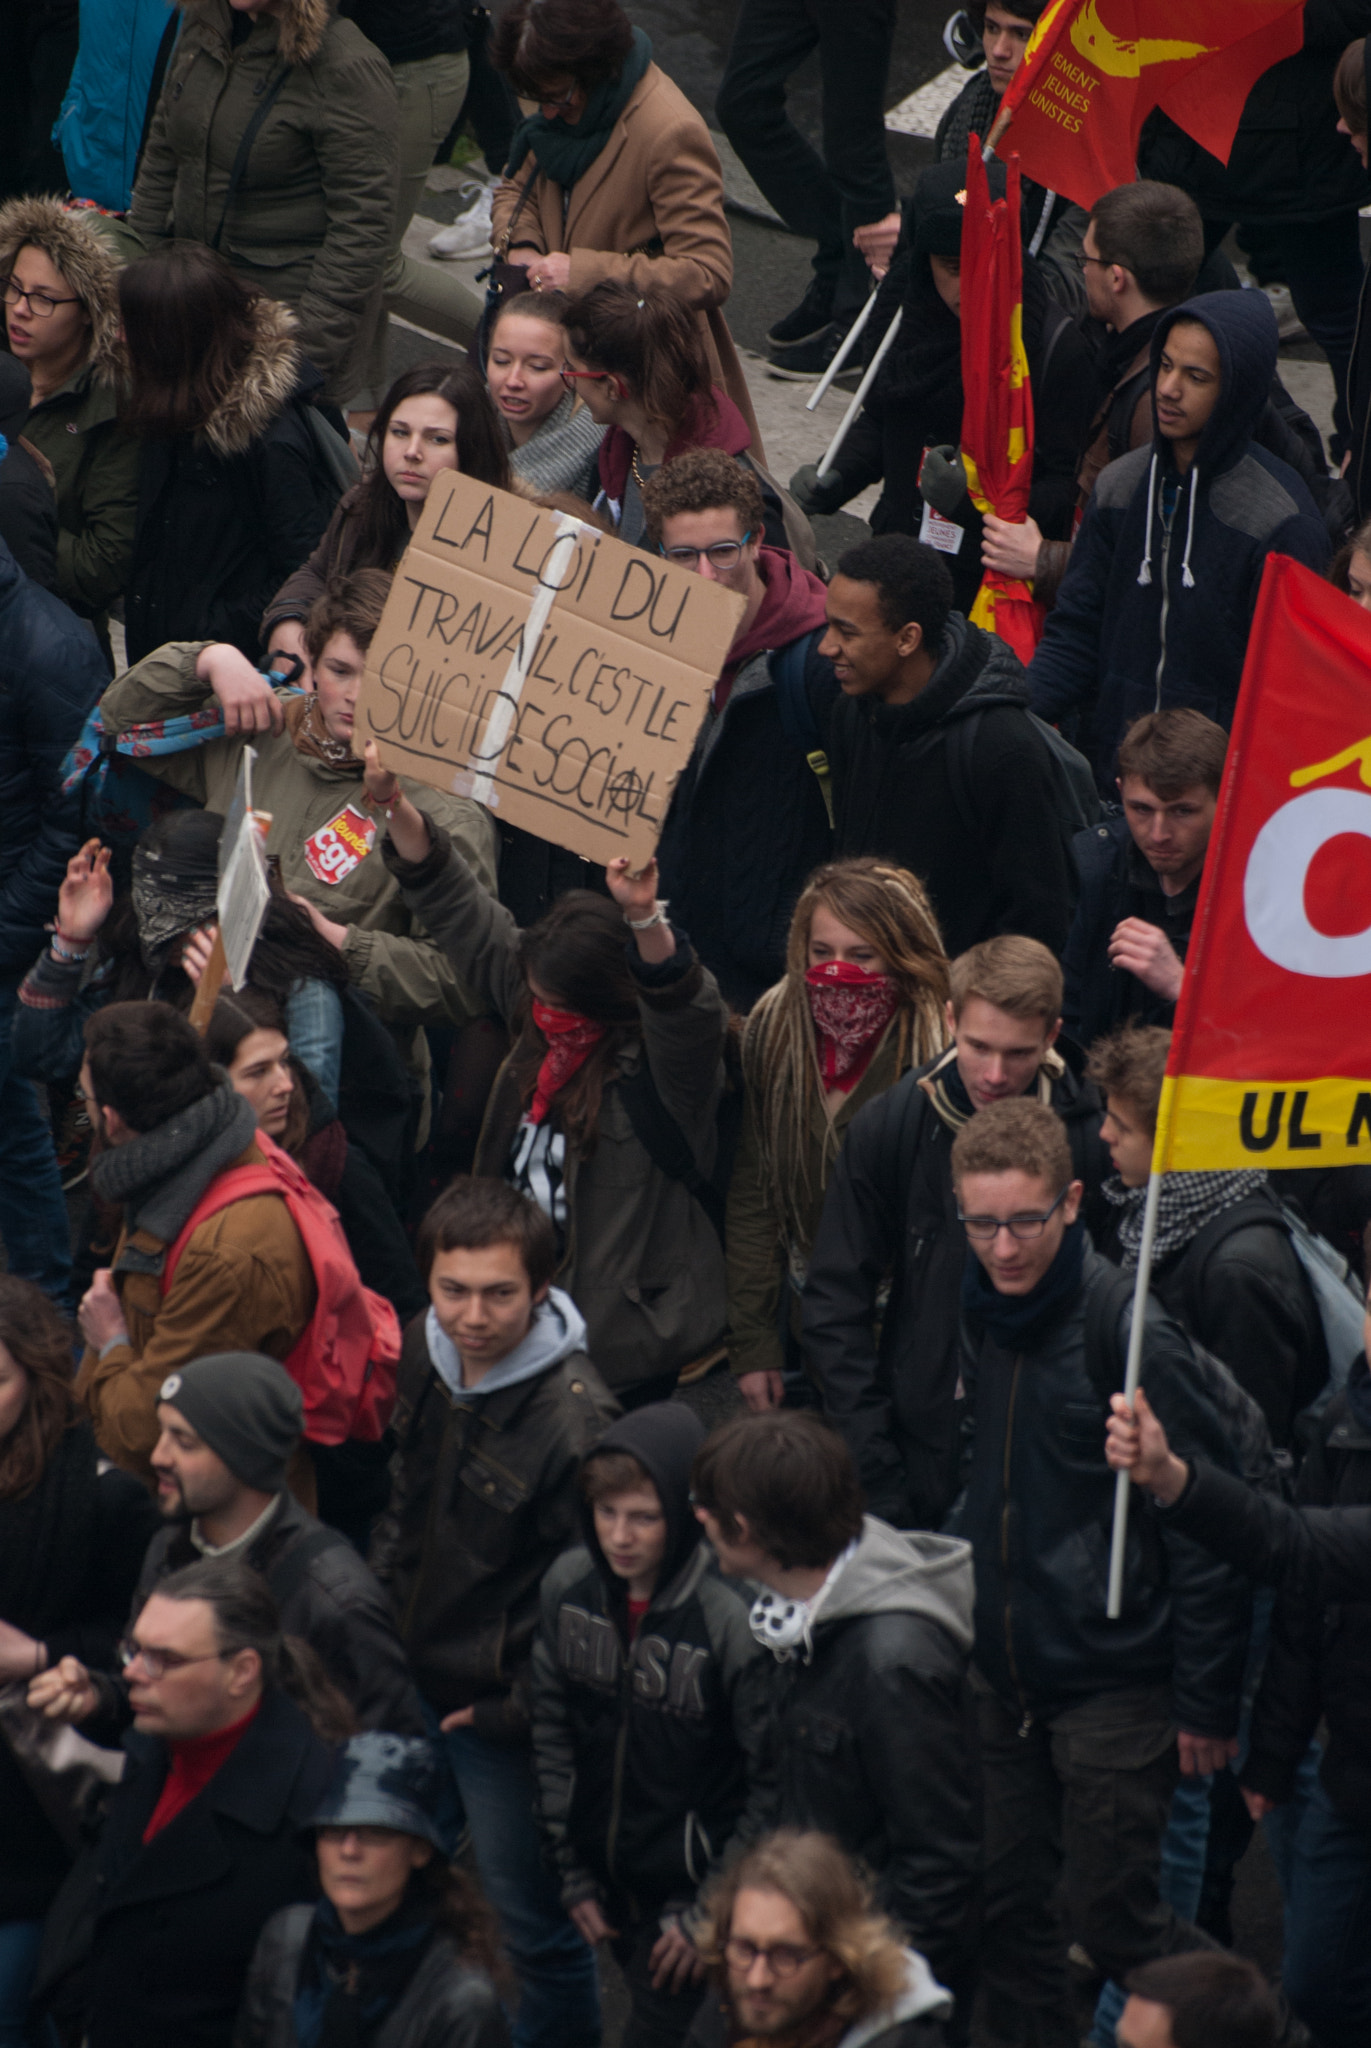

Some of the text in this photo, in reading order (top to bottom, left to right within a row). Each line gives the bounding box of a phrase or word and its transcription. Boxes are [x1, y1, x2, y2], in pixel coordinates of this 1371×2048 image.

[1042, 73, 1090, 113] JEUNES
[432, 488, 494, 562] LA
[610, 559, 691, 643] DU
[314, 828, 359, 881] cgt
[325, 814, 369, 856] jeunes
[1240, 1091, 1322, 1153] UL
